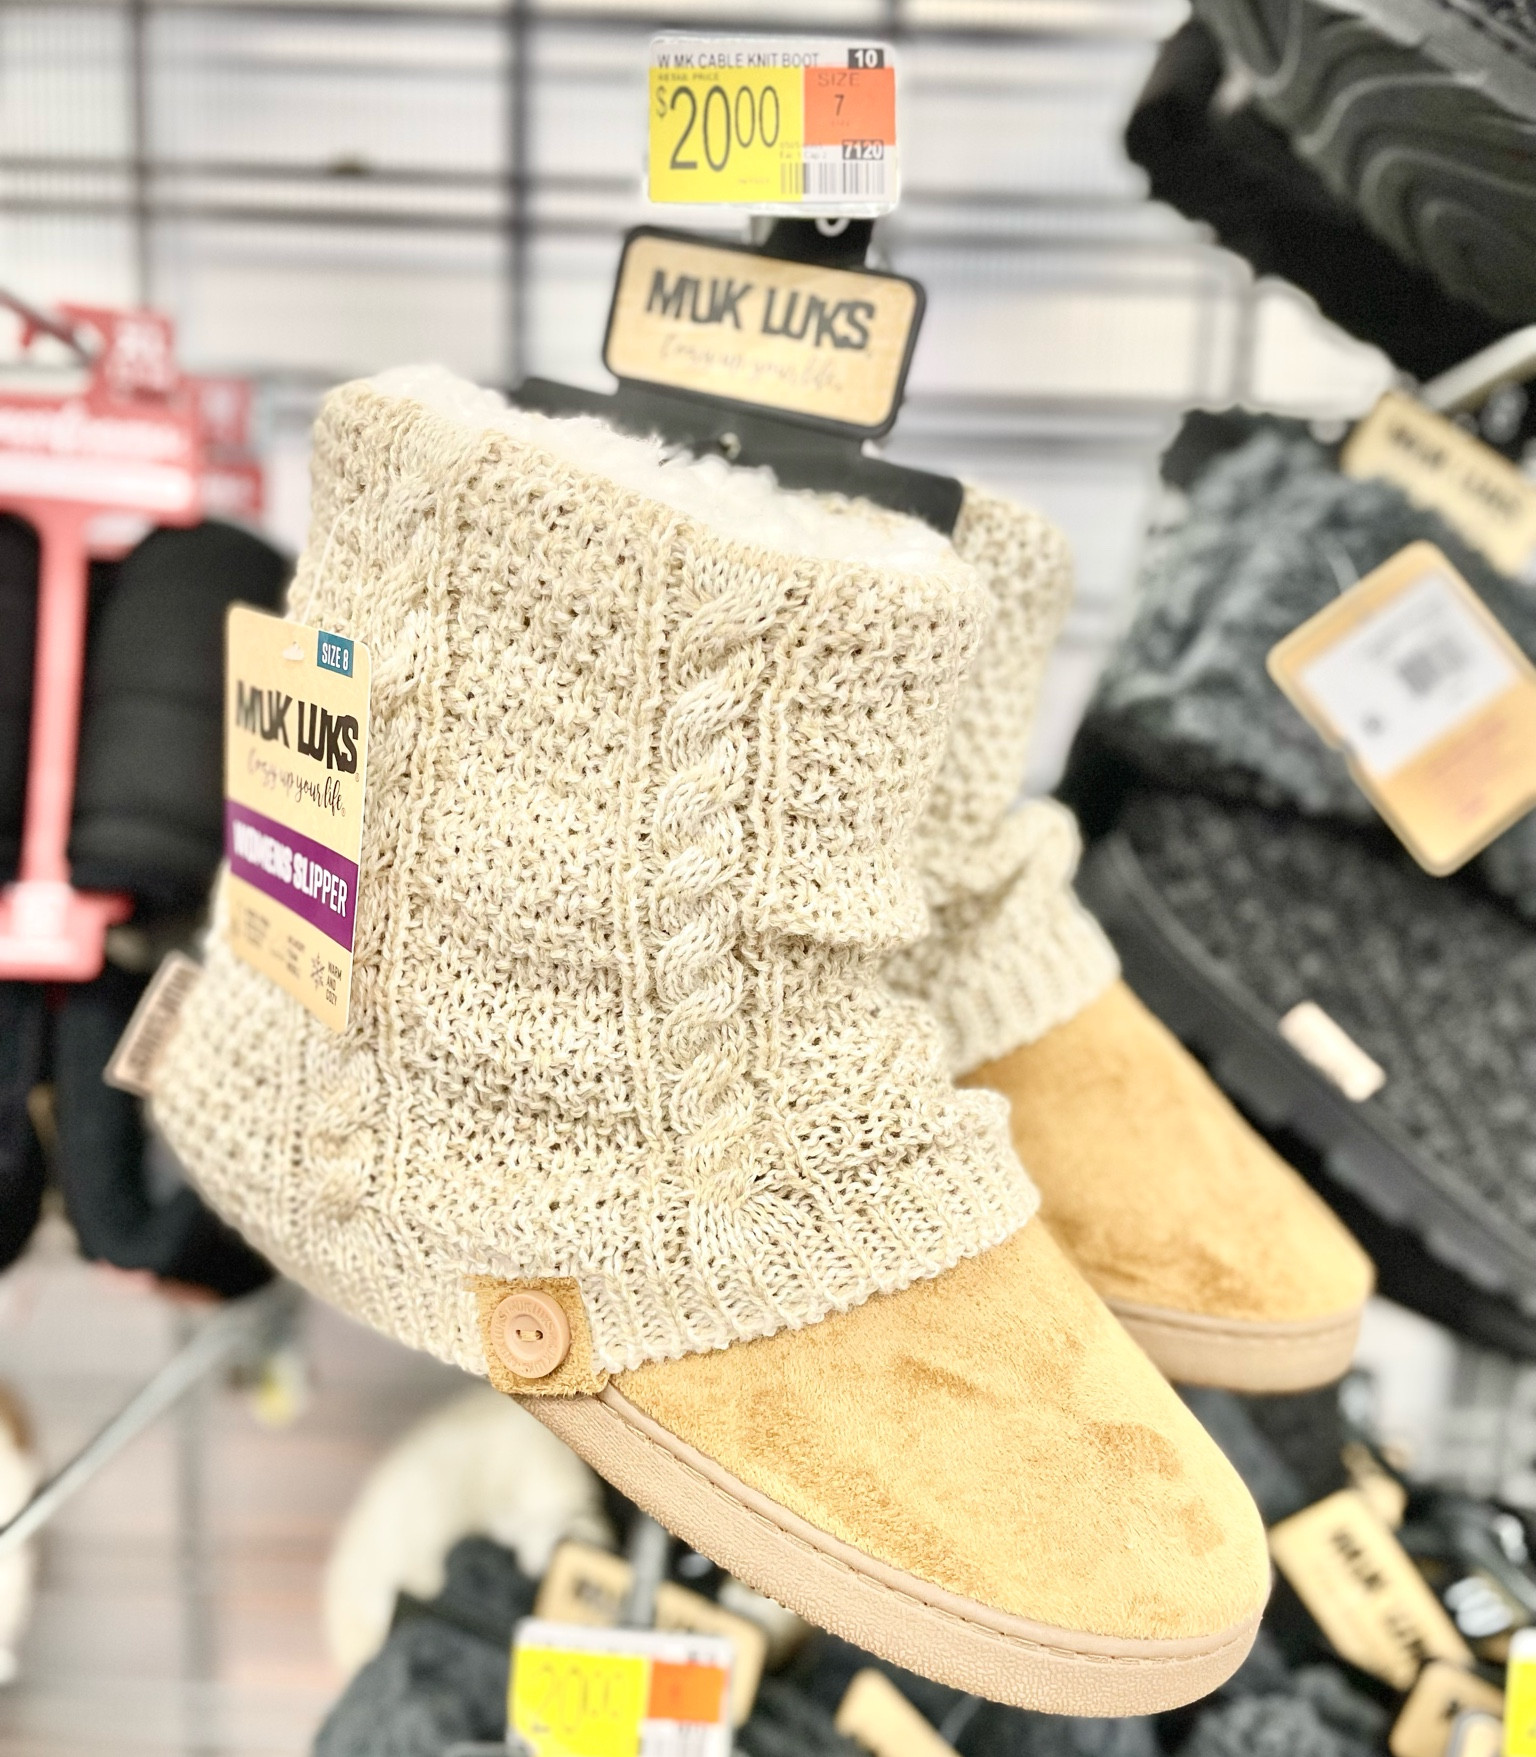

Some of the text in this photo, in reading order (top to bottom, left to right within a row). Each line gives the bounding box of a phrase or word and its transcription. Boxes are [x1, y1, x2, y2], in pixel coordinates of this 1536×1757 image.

[657, 52, 820, 69] W MK CABLE KNIT BOOT
[854, 49, 878, 68] 10
[818, 72, 861, 88] SIZE
[834, 93, 845, 117] 7
[843, 140, 883, 160] 7120
[645, 268, 876, 351] MUK LUKS
[321, 642, 349, 671] SIZE 8
[236, 678, 359, 775] MUK LUKS
[294, 774, 322, 808] your
[323, 776, 343, 817] life
[231, 818, 348, 918] WOMENS SLIPPER
[327, 961, 342, 982] WARM
[326, 975, 337, 991] AND
[325, 988, 338, 1006] COZY
